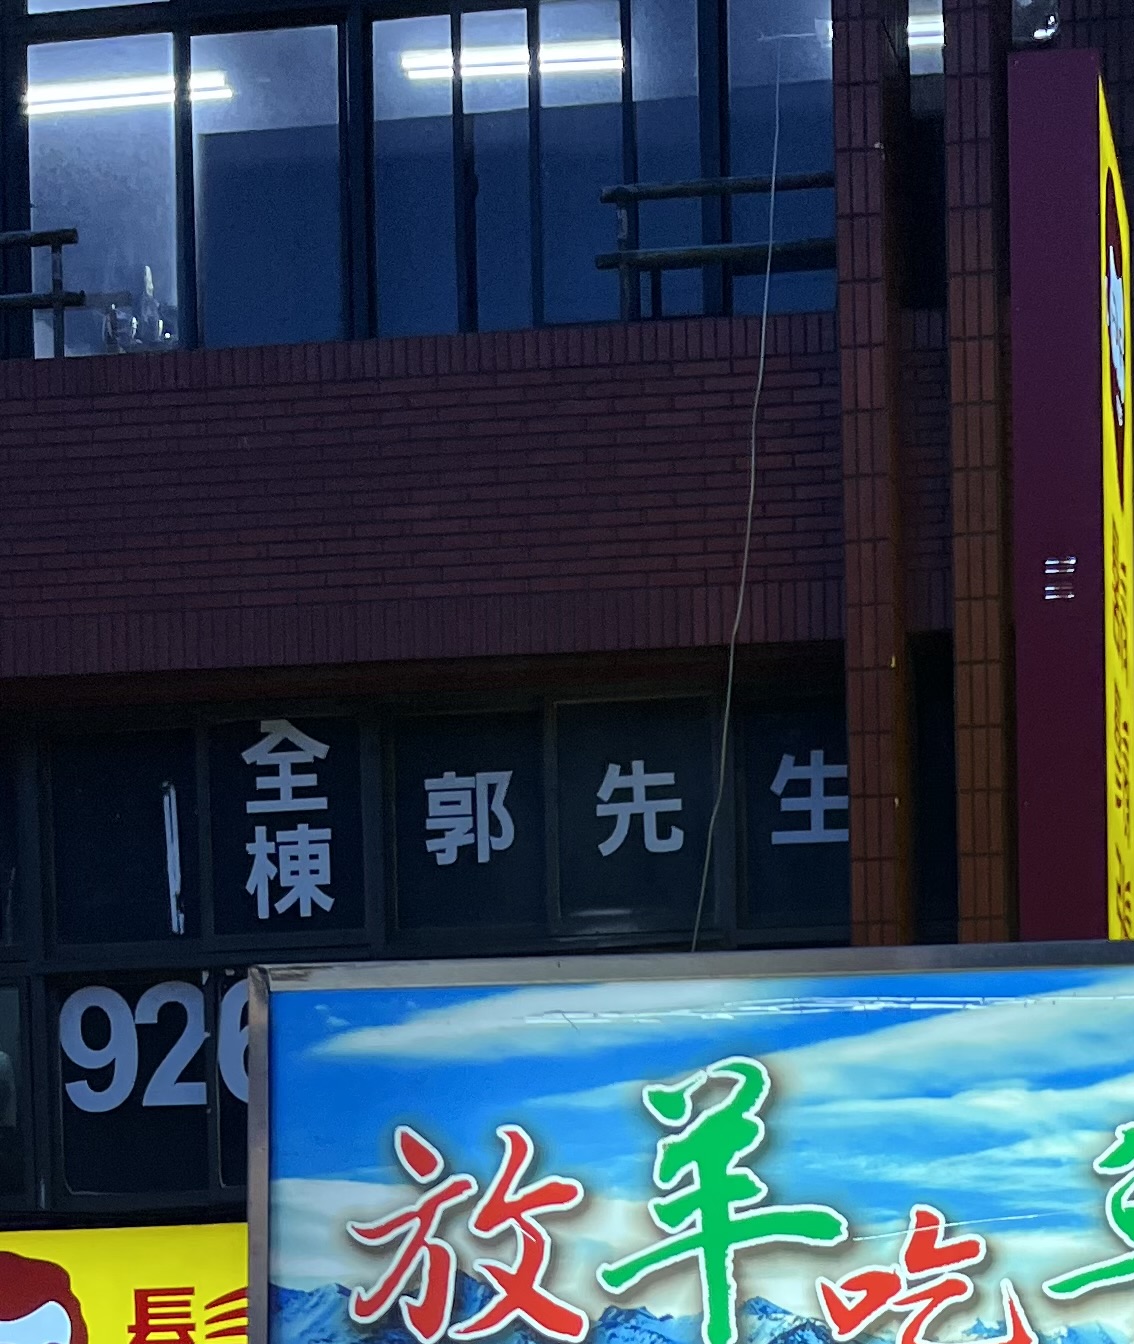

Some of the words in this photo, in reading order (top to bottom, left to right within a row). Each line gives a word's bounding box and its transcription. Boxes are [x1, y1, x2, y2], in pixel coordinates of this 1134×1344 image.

[241, 718, 335, 920] 全棟
[424, 749, 849, 866] 郭先生
